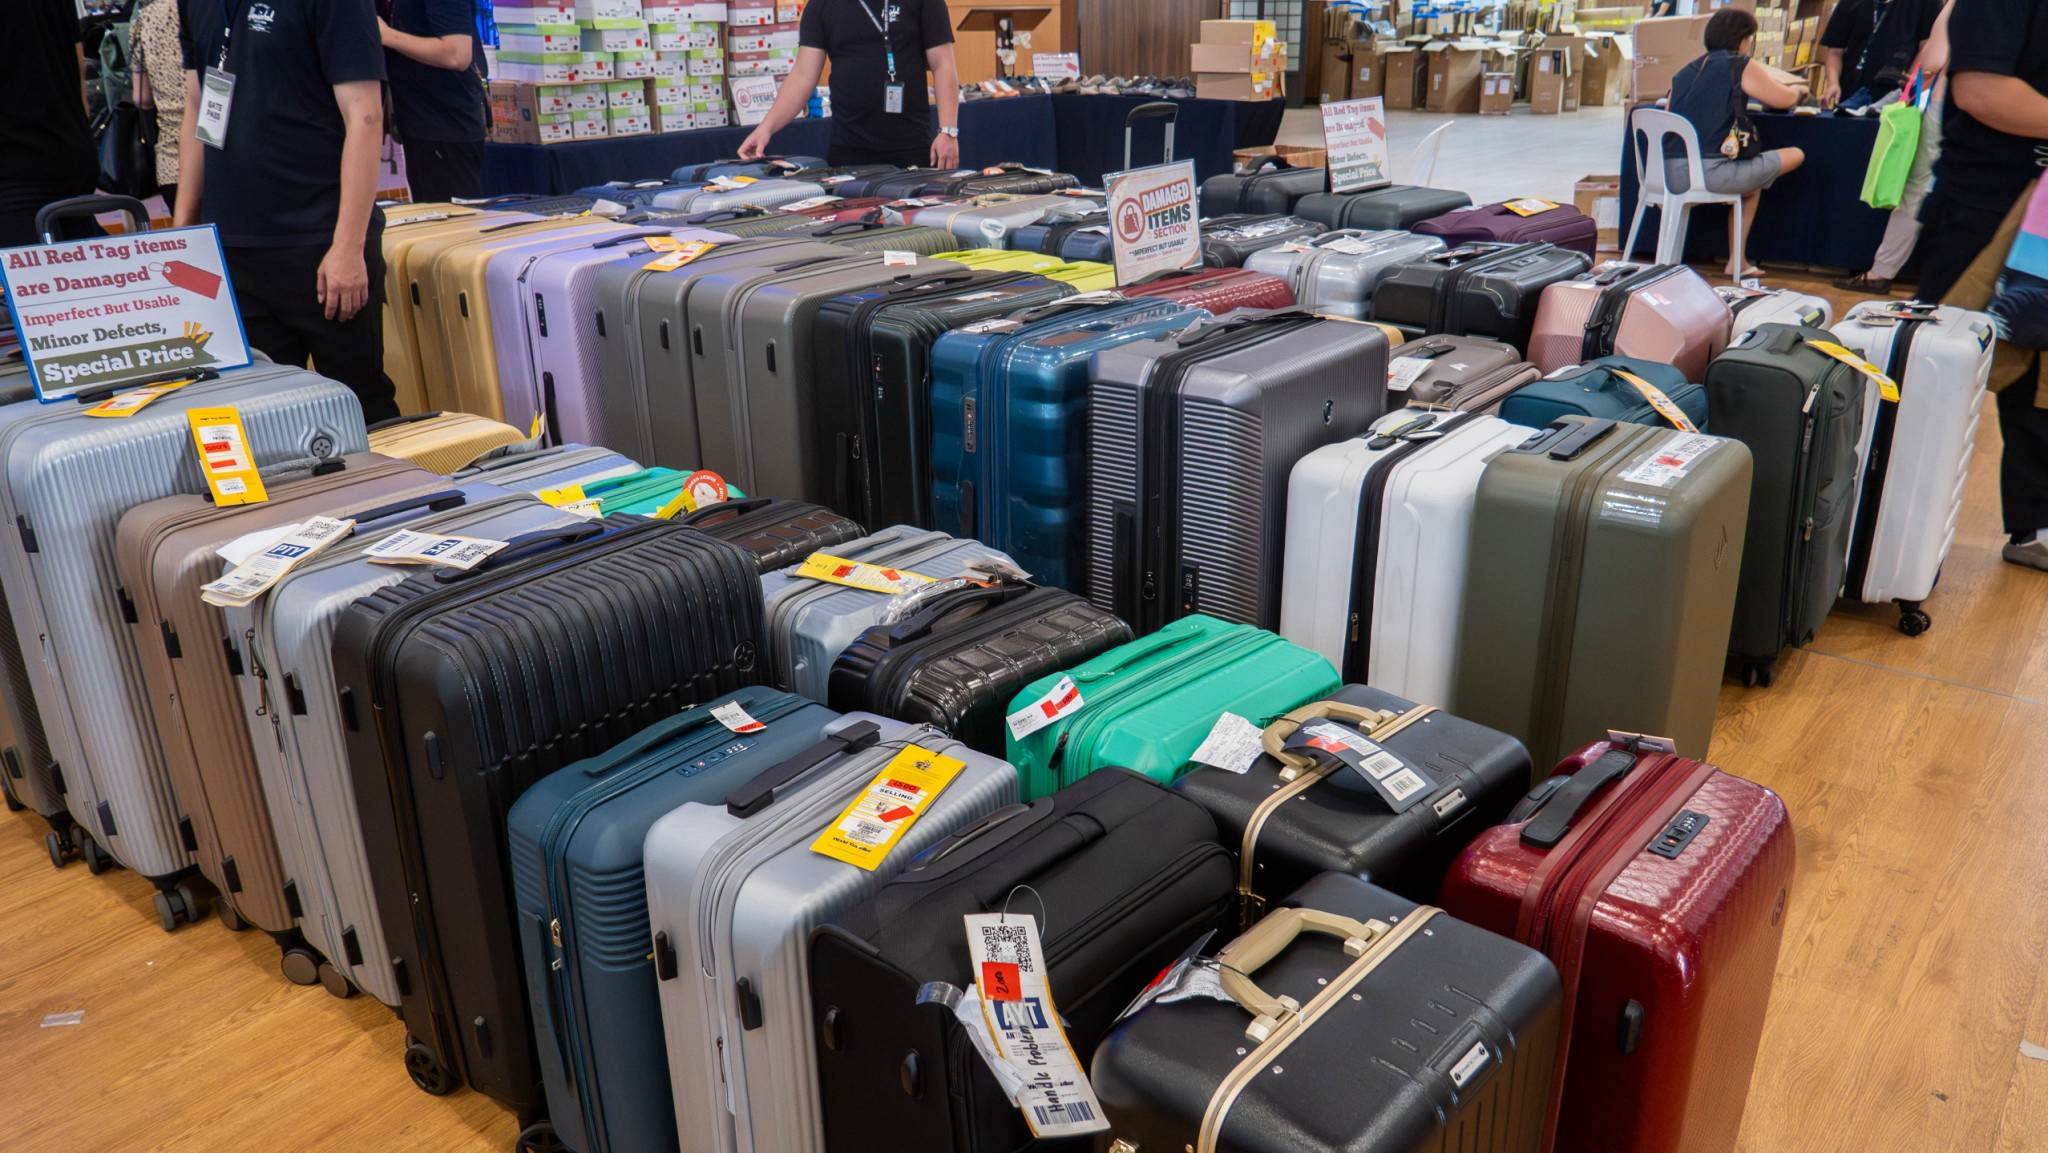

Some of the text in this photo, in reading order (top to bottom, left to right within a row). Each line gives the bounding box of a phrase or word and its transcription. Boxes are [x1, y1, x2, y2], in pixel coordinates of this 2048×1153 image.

[1333, 166, 1377, 185] Special Price
[1142, 181, 1189, 211] DAMAGED
[1147, 203, 1192, 230] ITEMS
[1153, 223, 1187, 239] SECTION
[9, 237, 188, 269] All Red Tag items
[16, 266, 151, 298] are Damaged
[23, 294, 181, 327] Imperfect But Usable
[29, 321, 168, 352] Minor Defects,
[43, 344, 194, 384] Special Price
[271, 544, 304, 558] PTY
[422, 540, 459, 556] TPE
[879, 787, 914, 801] SELLING
[1002, 1000, 1039, 1028] AYT
[1020, 1025, 1047, 1066] Problem
[1033, 1071, 1066, 1113] Handle
